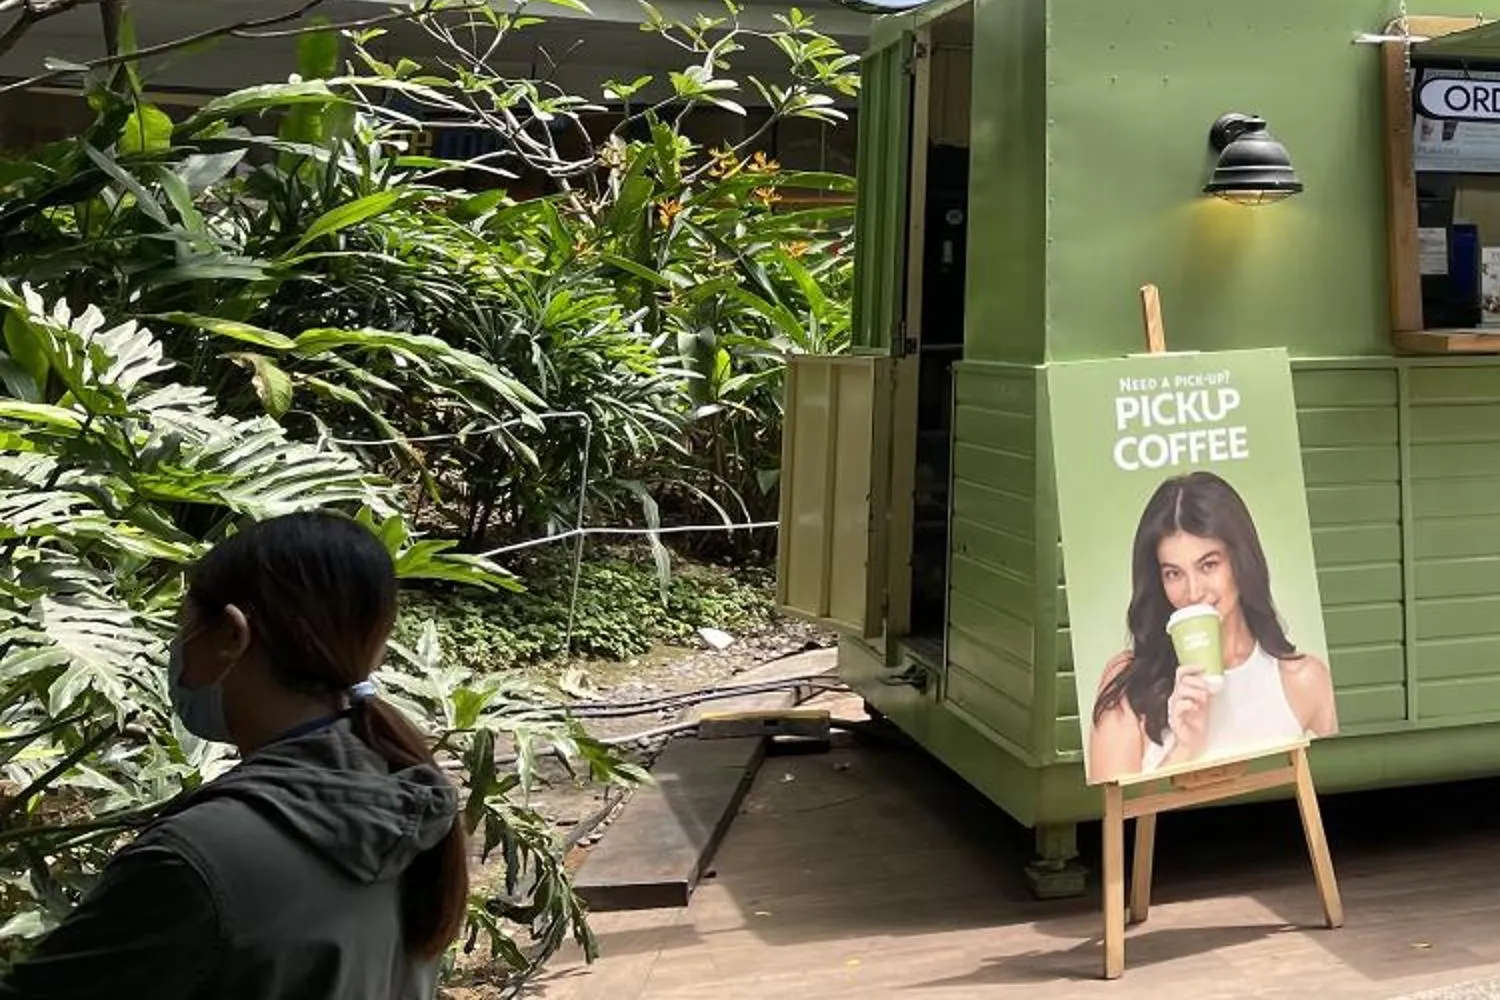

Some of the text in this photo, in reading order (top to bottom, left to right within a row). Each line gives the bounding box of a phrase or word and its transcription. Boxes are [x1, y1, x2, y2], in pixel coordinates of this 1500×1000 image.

[1160, 375, 1171, 389] A
[1115, 389, 1240, 430] PICKUP
[1114, 426, 1248, 470] COFFEE
